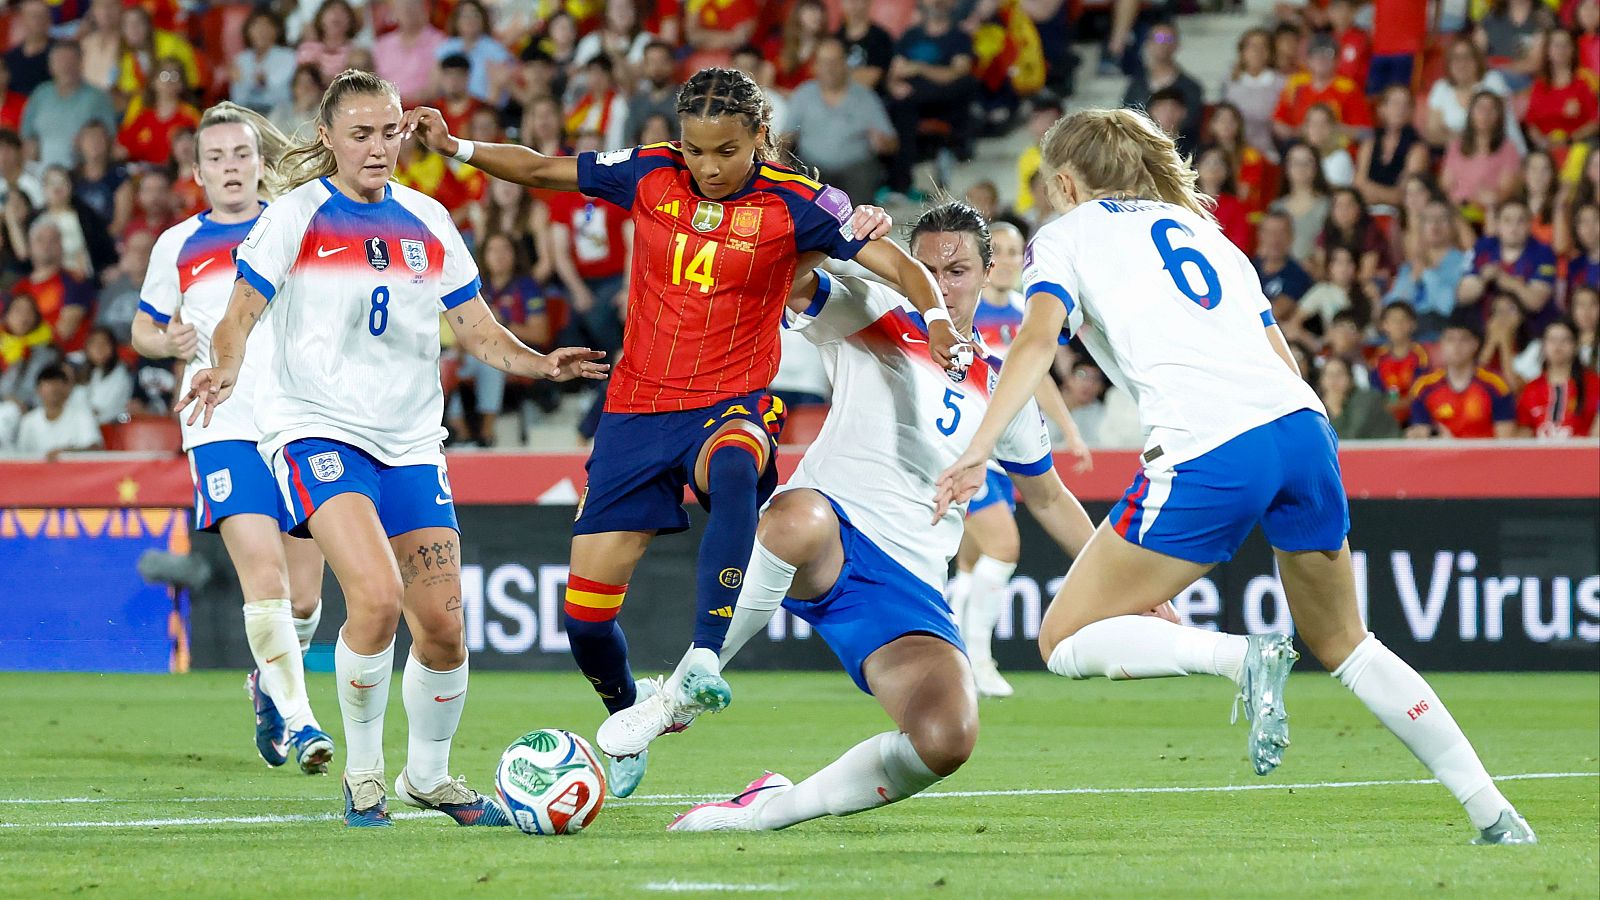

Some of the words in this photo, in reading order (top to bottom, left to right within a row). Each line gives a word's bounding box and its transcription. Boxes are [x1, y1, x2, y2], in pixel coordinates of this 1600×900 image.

[672, 233, 718, 293] 14
[1151, 219, 1222, 310] 6
[369, 286, 389, 336] 8
[936, 387, 965, 437] 5
[1243, 551, 1368, 636] dl
[1407, 700, 1429, 721] ENG
